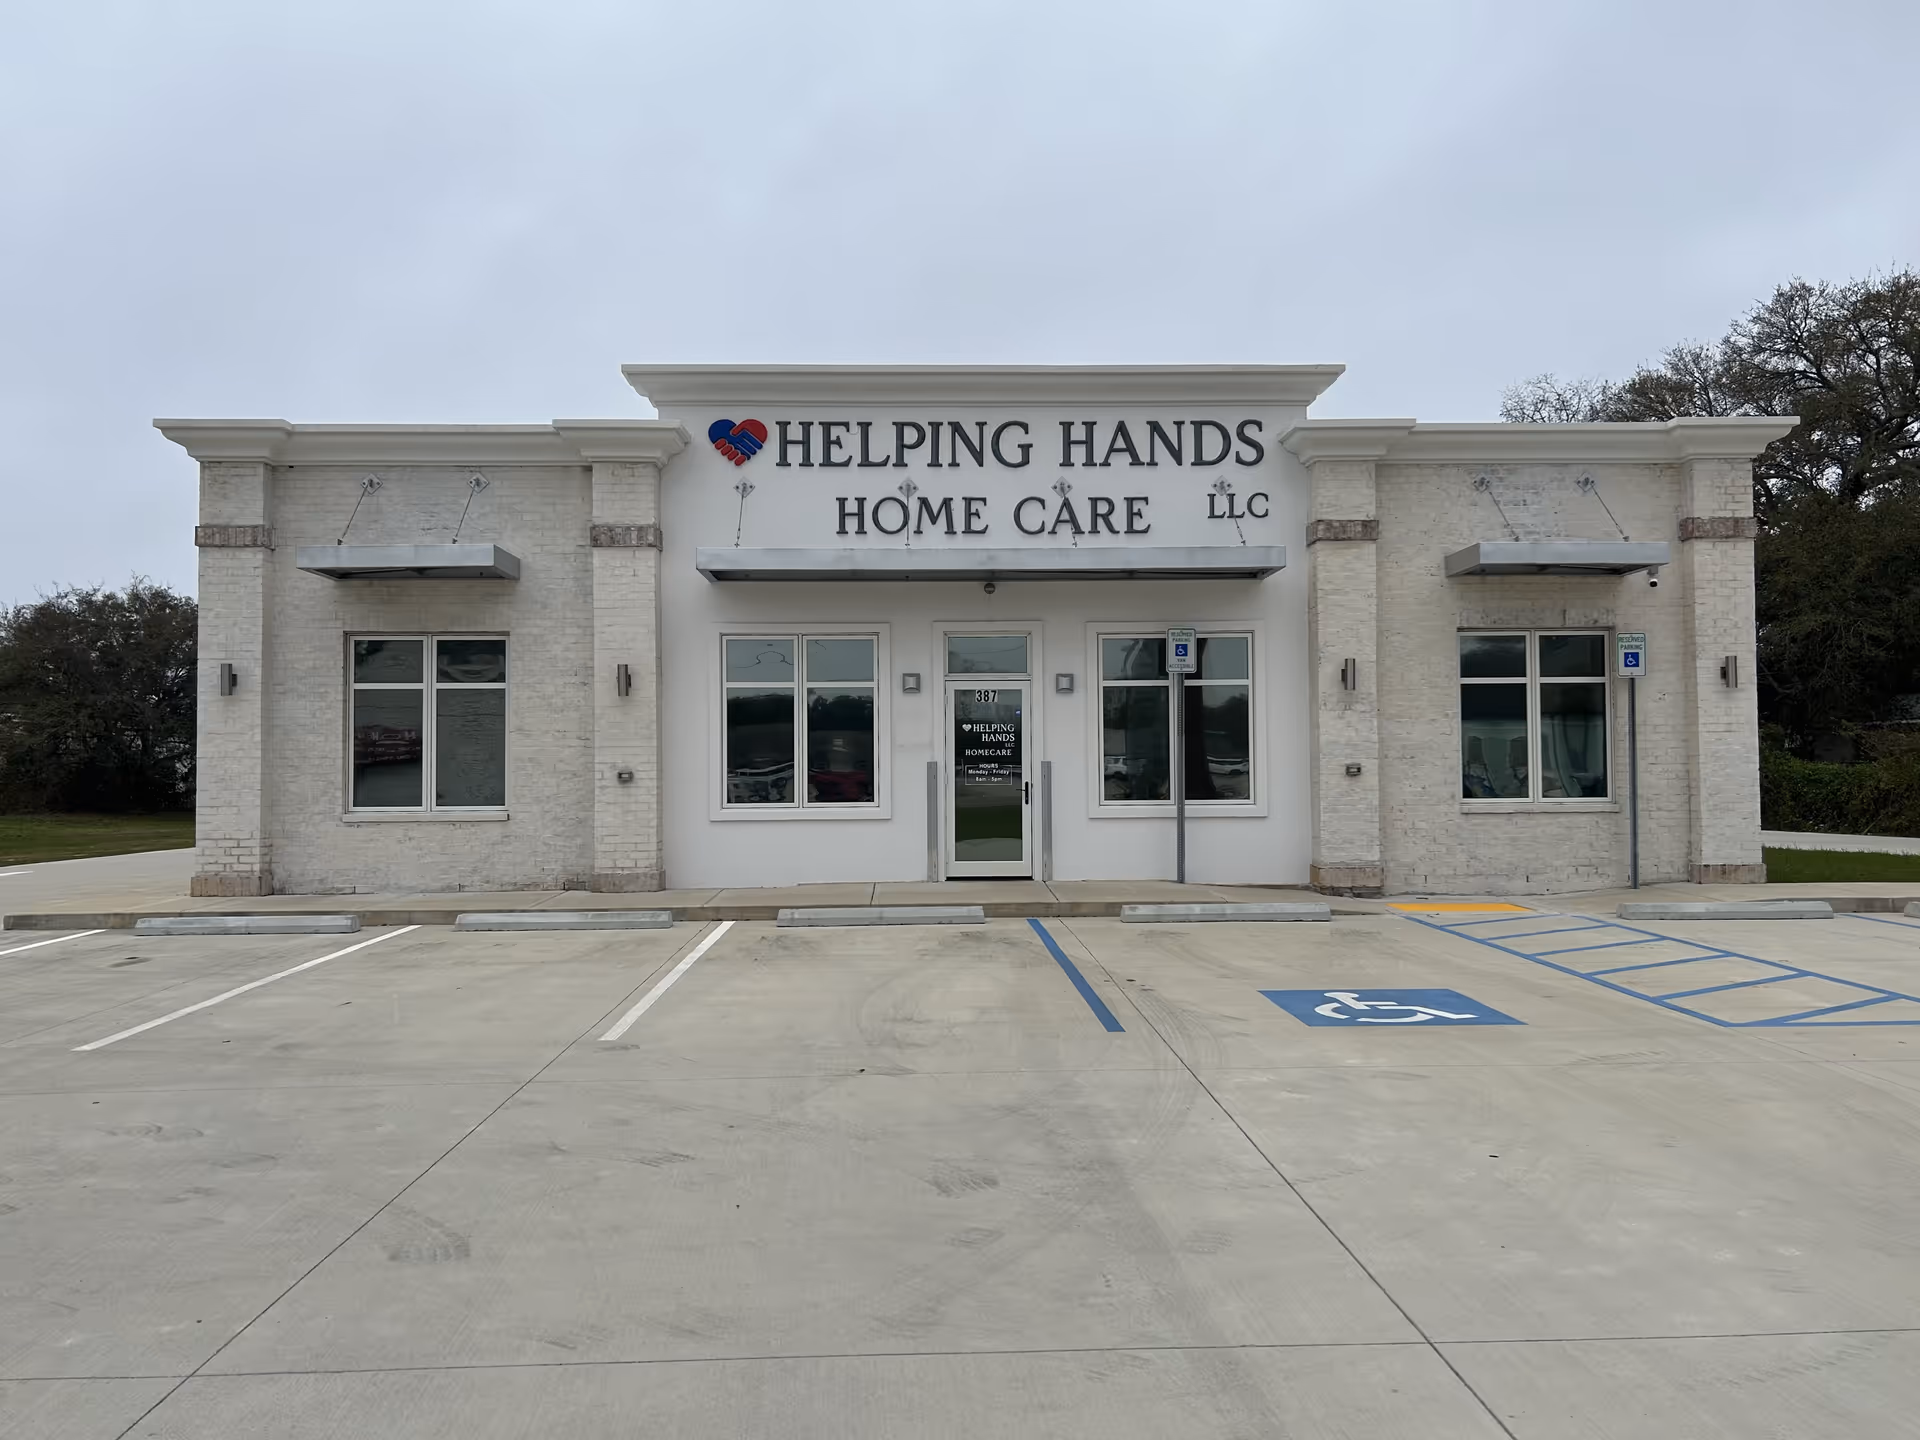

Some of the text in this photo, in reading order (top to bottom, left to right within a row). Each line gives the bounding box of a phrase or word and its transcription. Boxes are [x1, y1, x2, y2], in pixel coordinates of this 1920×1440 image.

[775, 419, 1265, 468] HELPING HANDS
[835, 492, 1270, 535] HOME CARE LLC
[976, 690, 997, 702] 387
